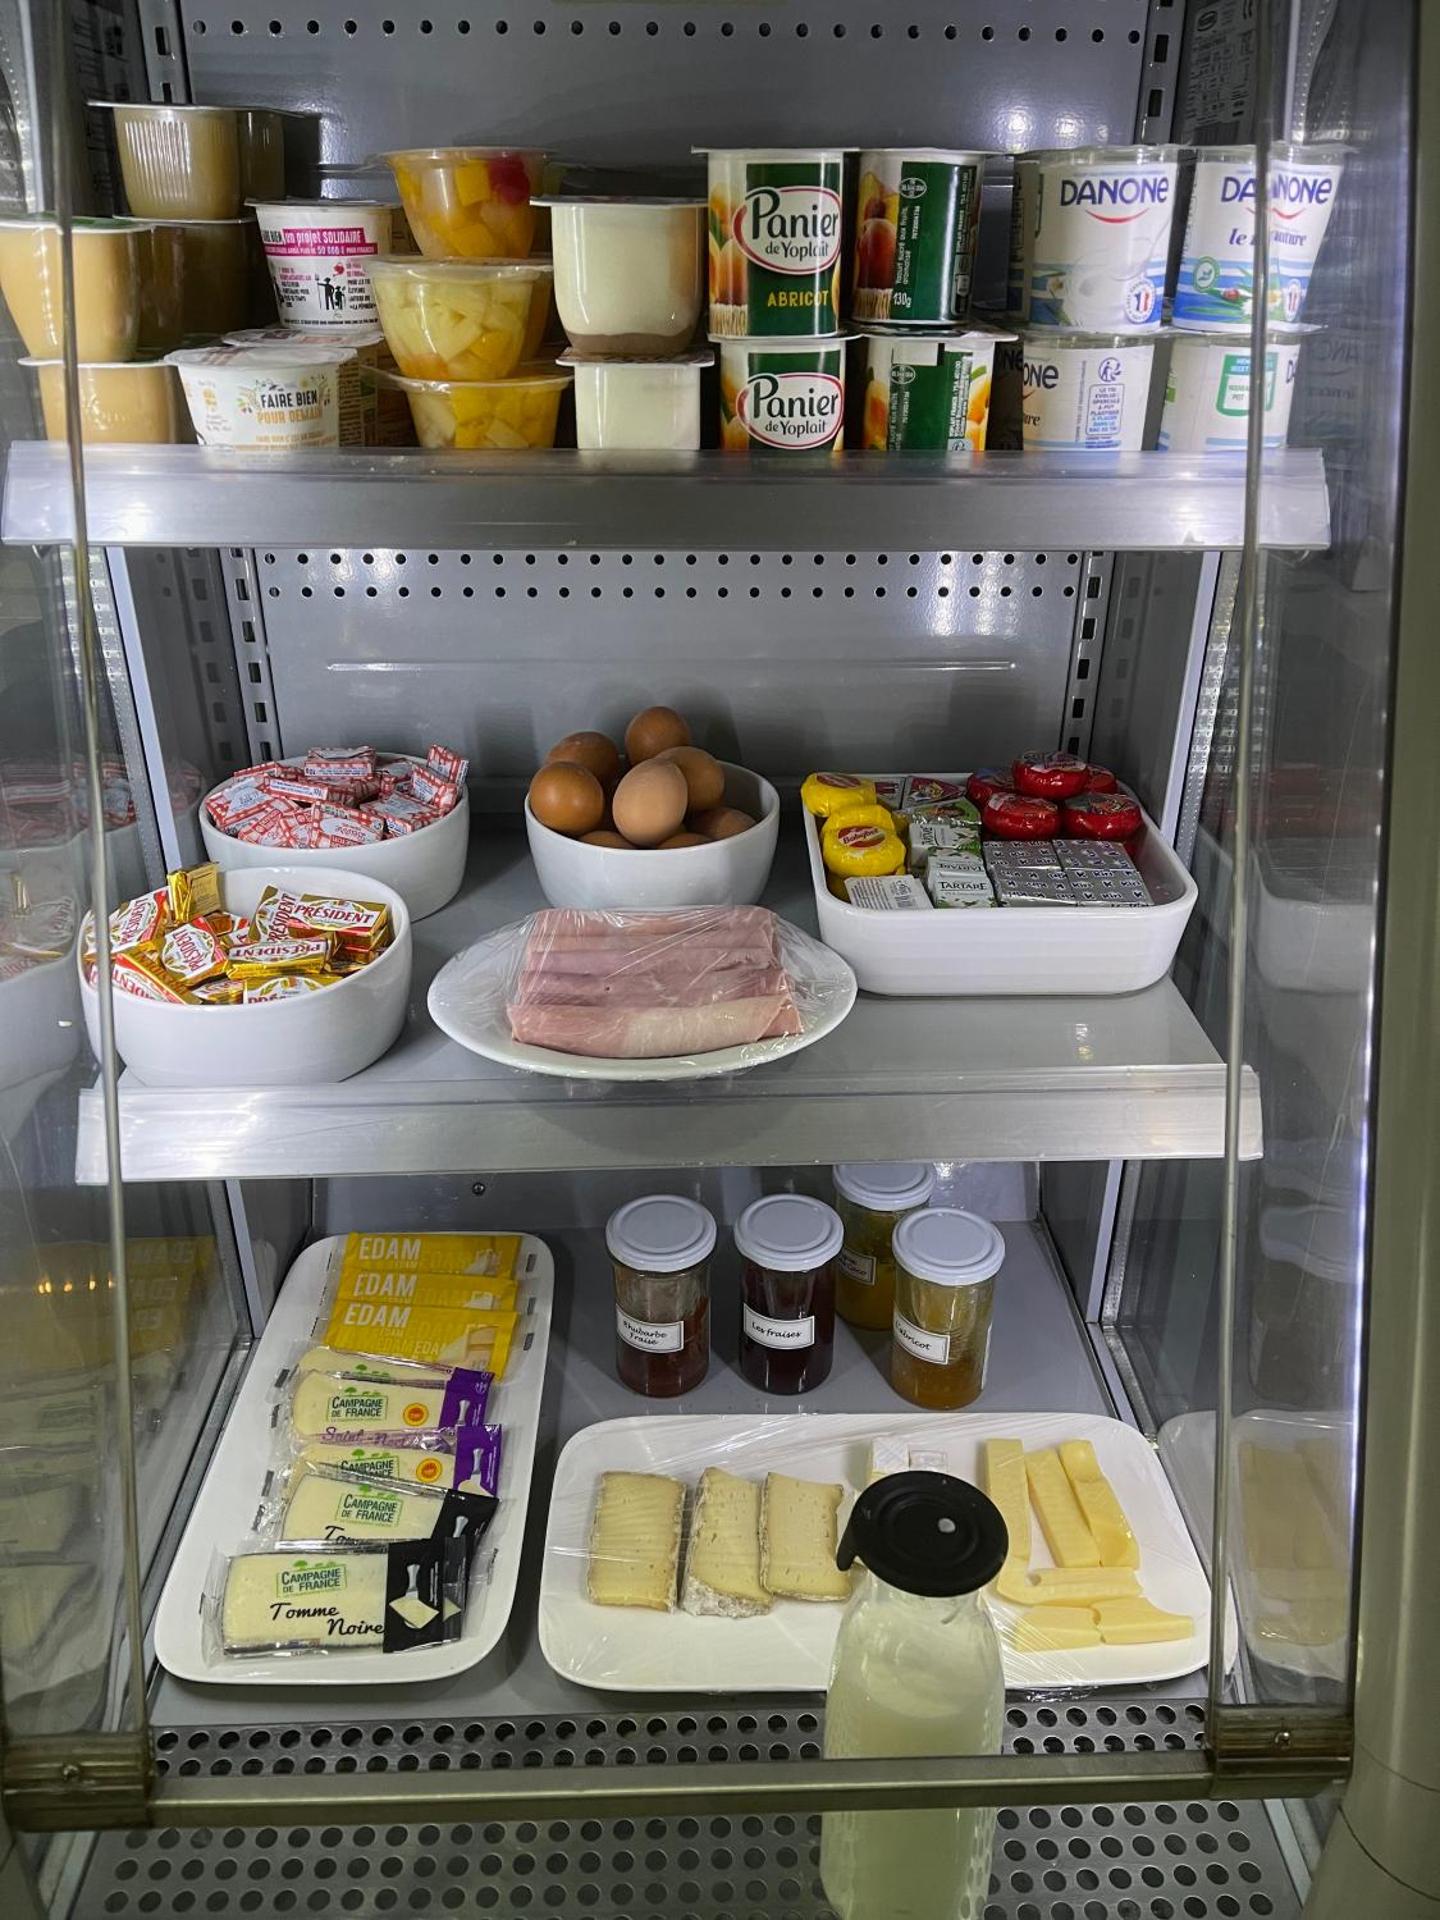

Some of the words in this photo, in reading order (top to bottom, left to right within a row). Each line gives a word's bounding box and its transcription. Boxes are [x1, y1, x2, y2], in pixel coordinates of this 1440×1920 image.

[745, 188, 839, 240] Panier
[1229, 228, 1247, 246] le
[765, 241, 780, 255] de
[780, 241, 829, 261] Yoplait
[768, 290, 829, 308] ABRICOT
[893, 292, 911, 308] 130g
[261, 392, 293, 409] FAIRE
[296, 390, 318, 406] BIEN
[747, 375, 839, 419] Panier
[257, 410, 287, 425] POUR
[765, 421, 779, 432] de
[779, 420, 826, 438] Yoplait
[843, 828, 880, 844] Babybel
[939, 881, 988, 891] TARTARE
[267, 893, 297, 942] PRÉSIDENT
[294, 904, 375, 924] PRÉSIDENT
[173, 928, 206, 972] PRÉSIDENT
[359, 1237, 422, 1262] EDAM
[352, 1273, 419, 1298] EDAM
[343, 1303, 413, 1329] EDAM
[752, 1321, 766, 1334] Les
[766, 1326, 802, 1339] fraises
[414, 1340, 440, 1356] EDA
[332, 1396, 384, 1409] CAMPAGNE
[332, 1410, 341, 1418] DE
[345, 1407, 382, 1418] FRANCE
[343, 1494, 398, 1515] CAMPAGNE
[341, 1510, 353, 1519] DE
[355, 1510, 395, 1523] FRANCE
[281, 1567, 341, 1585] CAMPAGNE
[282, 1584, 294, 1593] DE
[299, 1579, 341, 1591] FRANCE
[270, 1602, 341, 1621] Tomme
[327, 1618, 386, 1636] Noire
